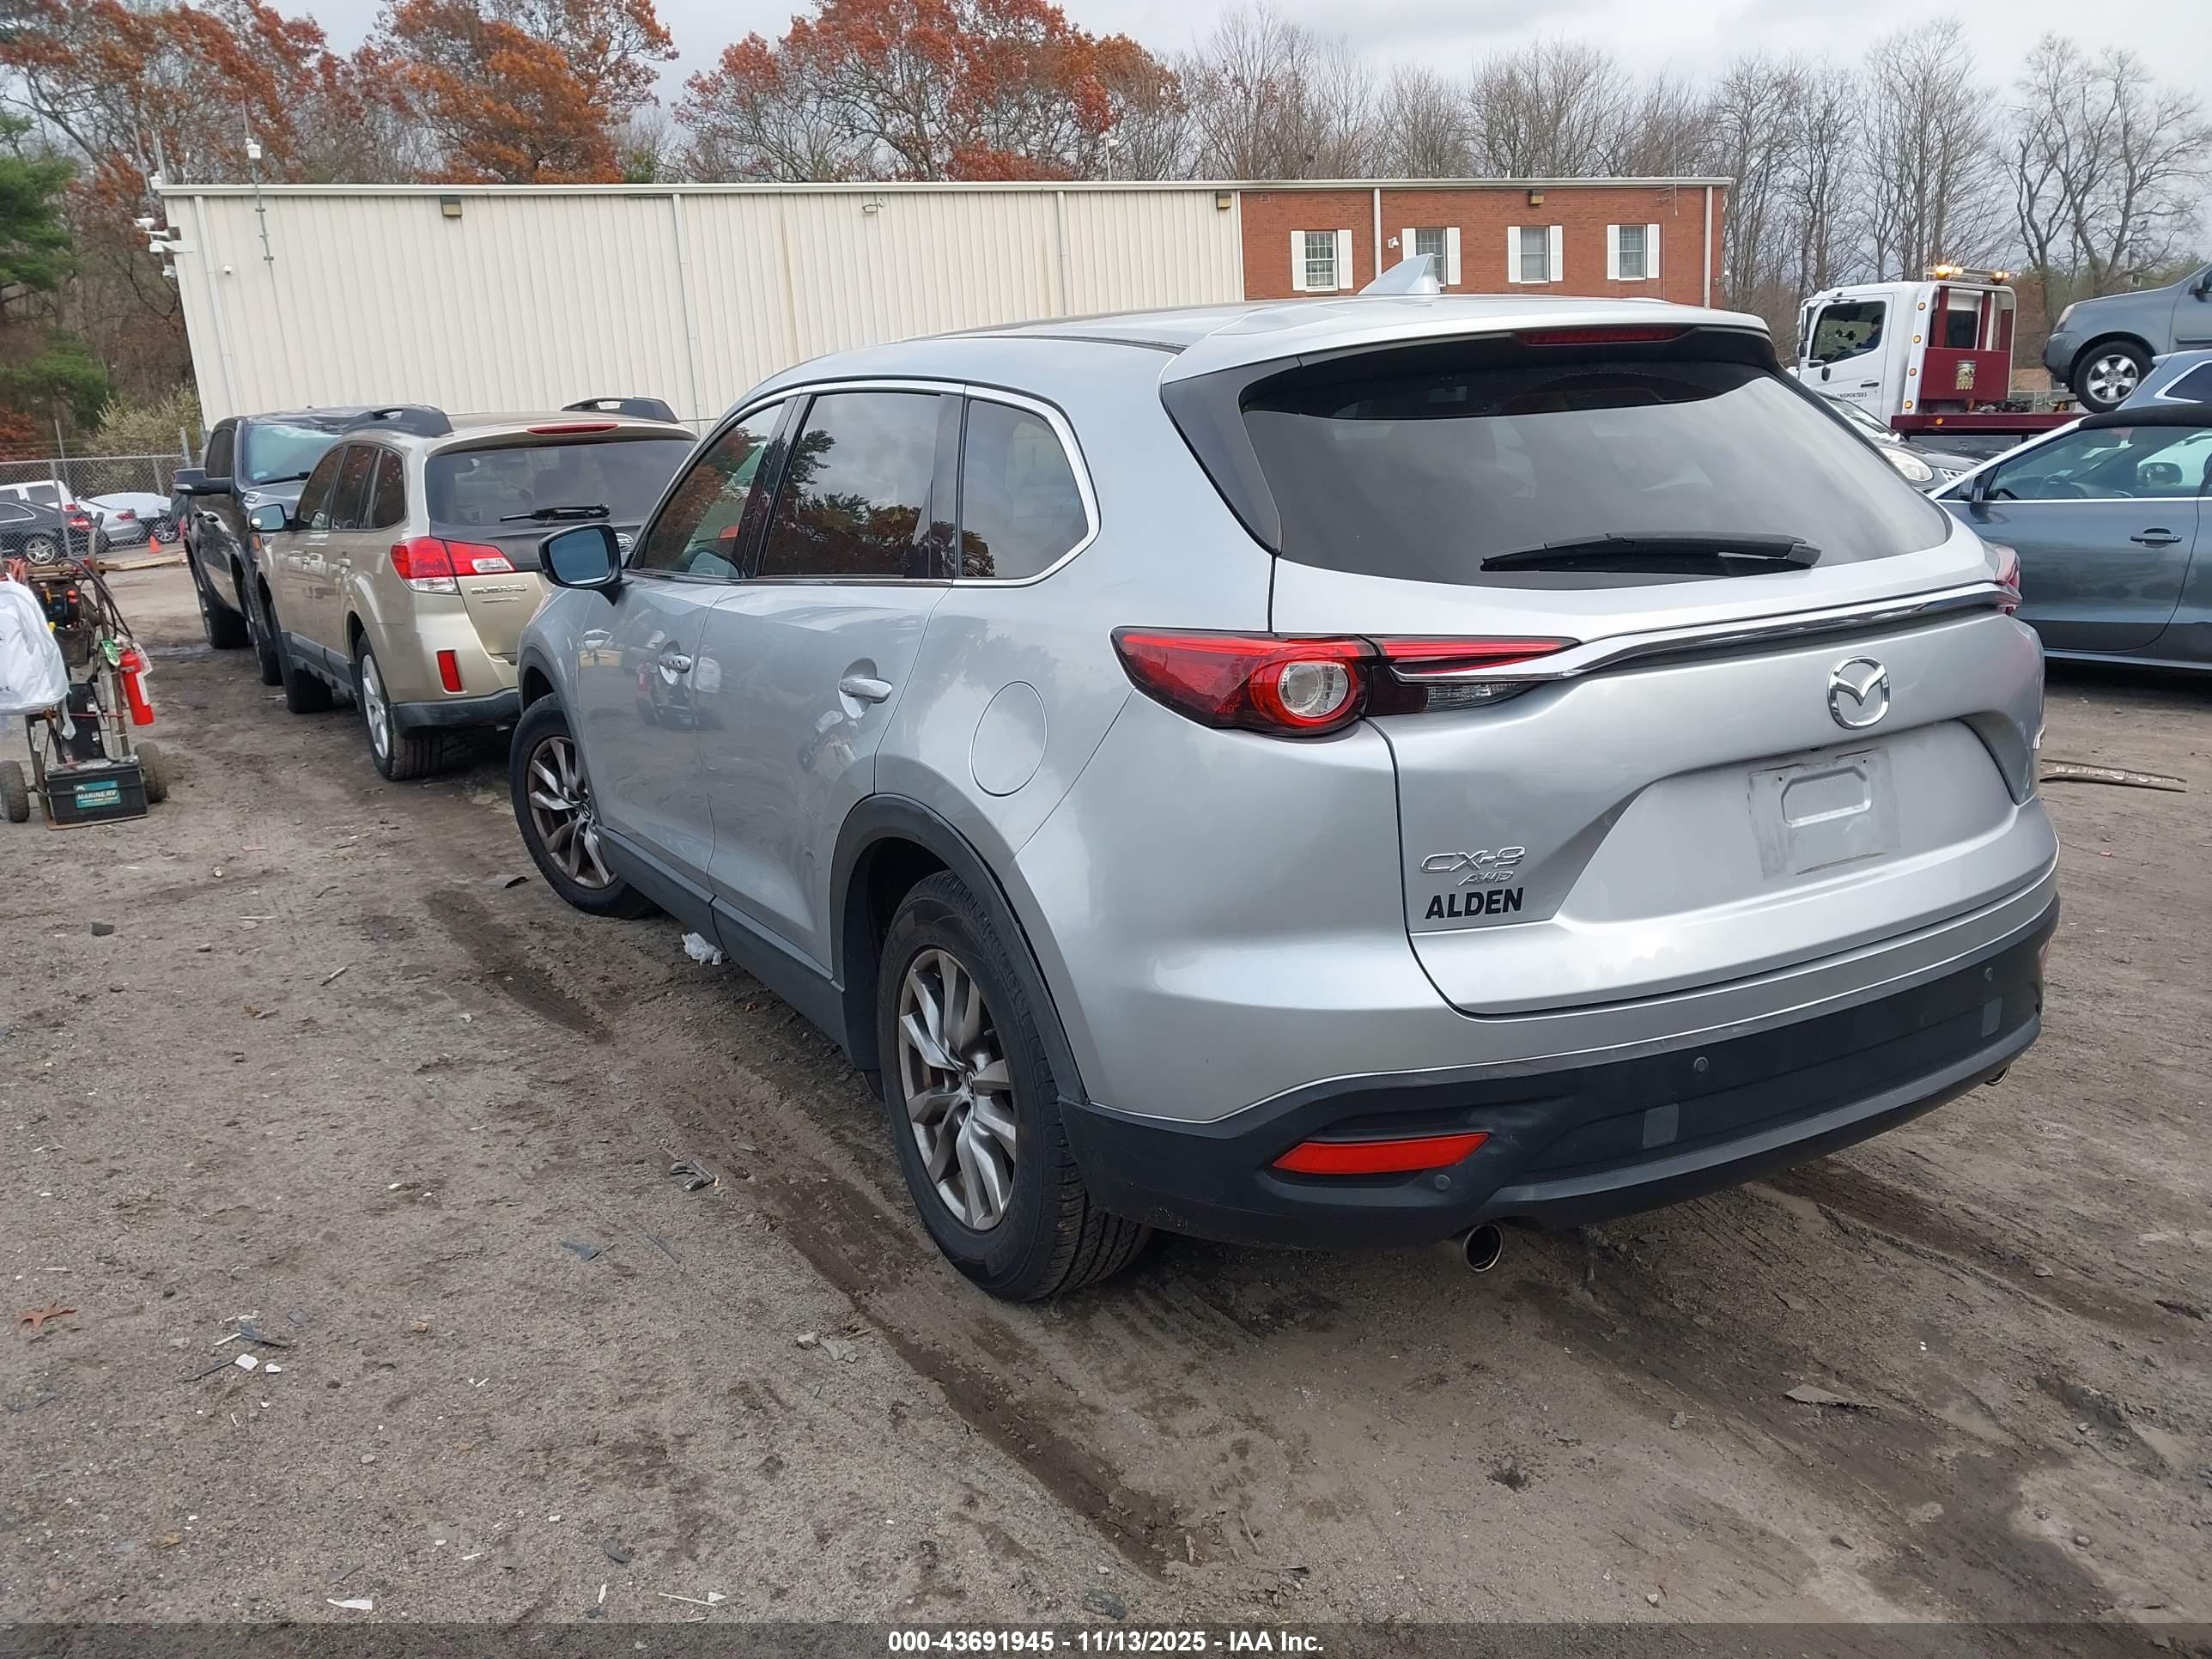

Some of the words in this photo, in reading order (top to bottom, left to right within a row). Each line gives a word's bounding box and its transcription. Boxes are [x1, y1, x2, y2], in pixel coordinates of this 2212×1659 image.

[1420, 846, 1526, 873] CX-9
[1457, 870, 1514, 886] AWD
[1425, 887, 1524, 919] ALDEN
